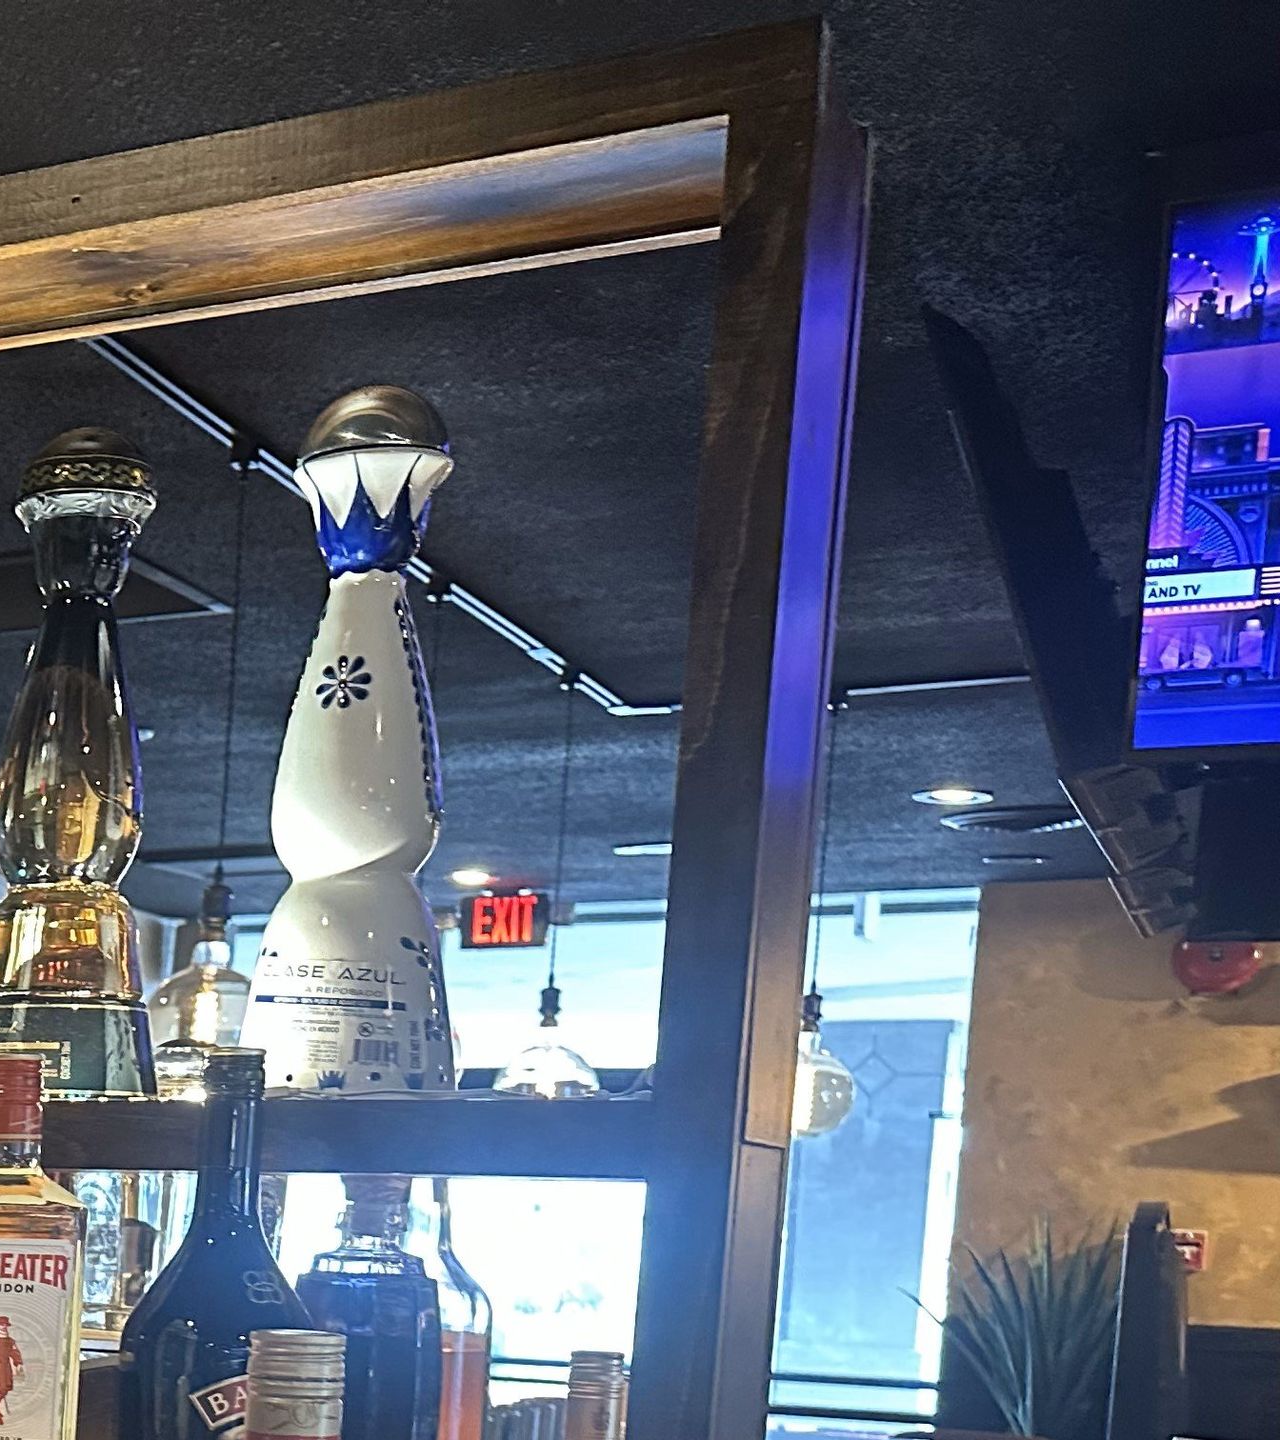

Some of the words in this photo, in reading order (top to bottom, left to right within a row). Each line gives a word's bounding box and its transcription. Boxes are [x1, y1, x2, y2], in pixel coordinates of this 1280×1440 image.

[1148, 586, 1178, 598] AND
[1183, 584, 1201, 596] TV
[472, 896, 538, 944] EXIT
[337, 966, 406, 986] AZUL
[312, 986, 383, 998] REPOSADO
